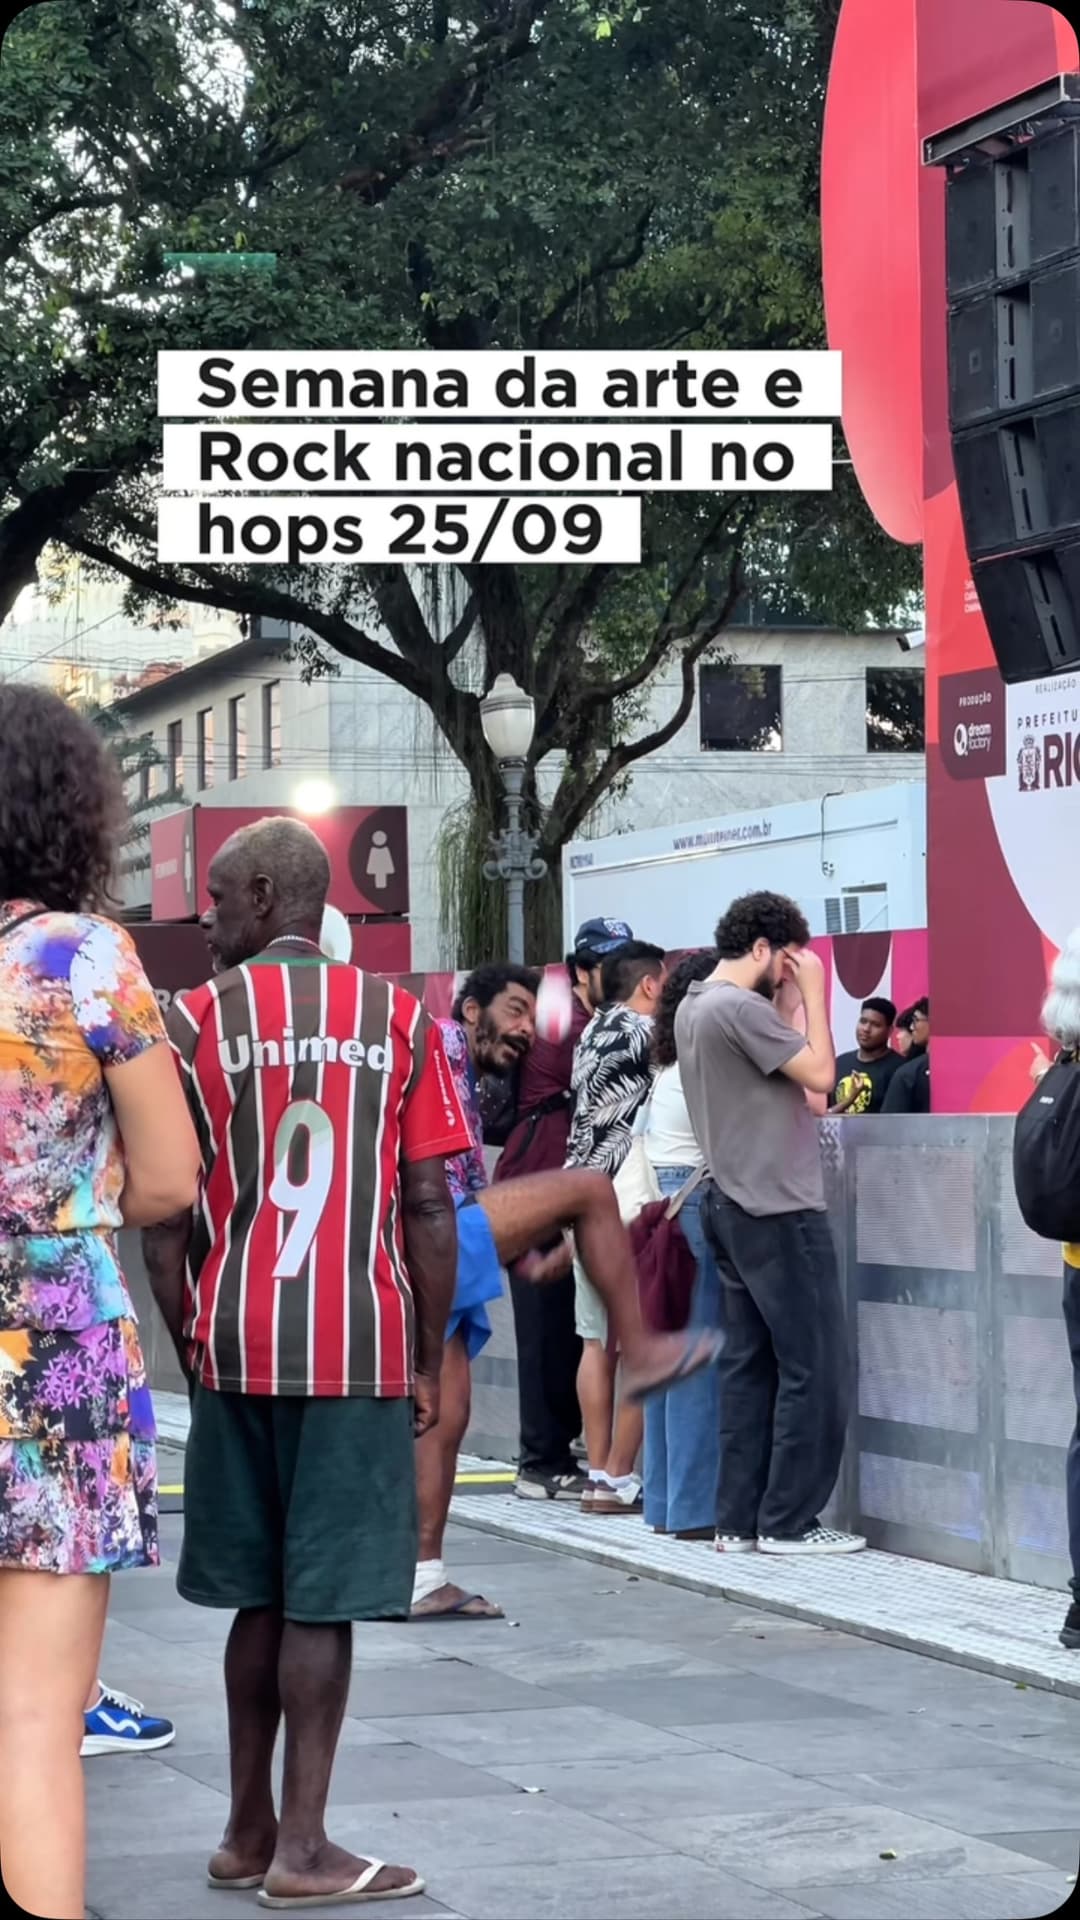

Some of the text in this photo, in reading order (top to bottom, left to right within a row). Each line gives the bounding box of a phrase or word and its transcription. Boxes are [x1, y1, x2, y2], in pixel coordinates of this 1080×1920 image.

[1017, 709, 1078, 729] PREFEITU
[217, 1027, 393, 1074] Unimed
[268, 1098, 334, 1278] 9
